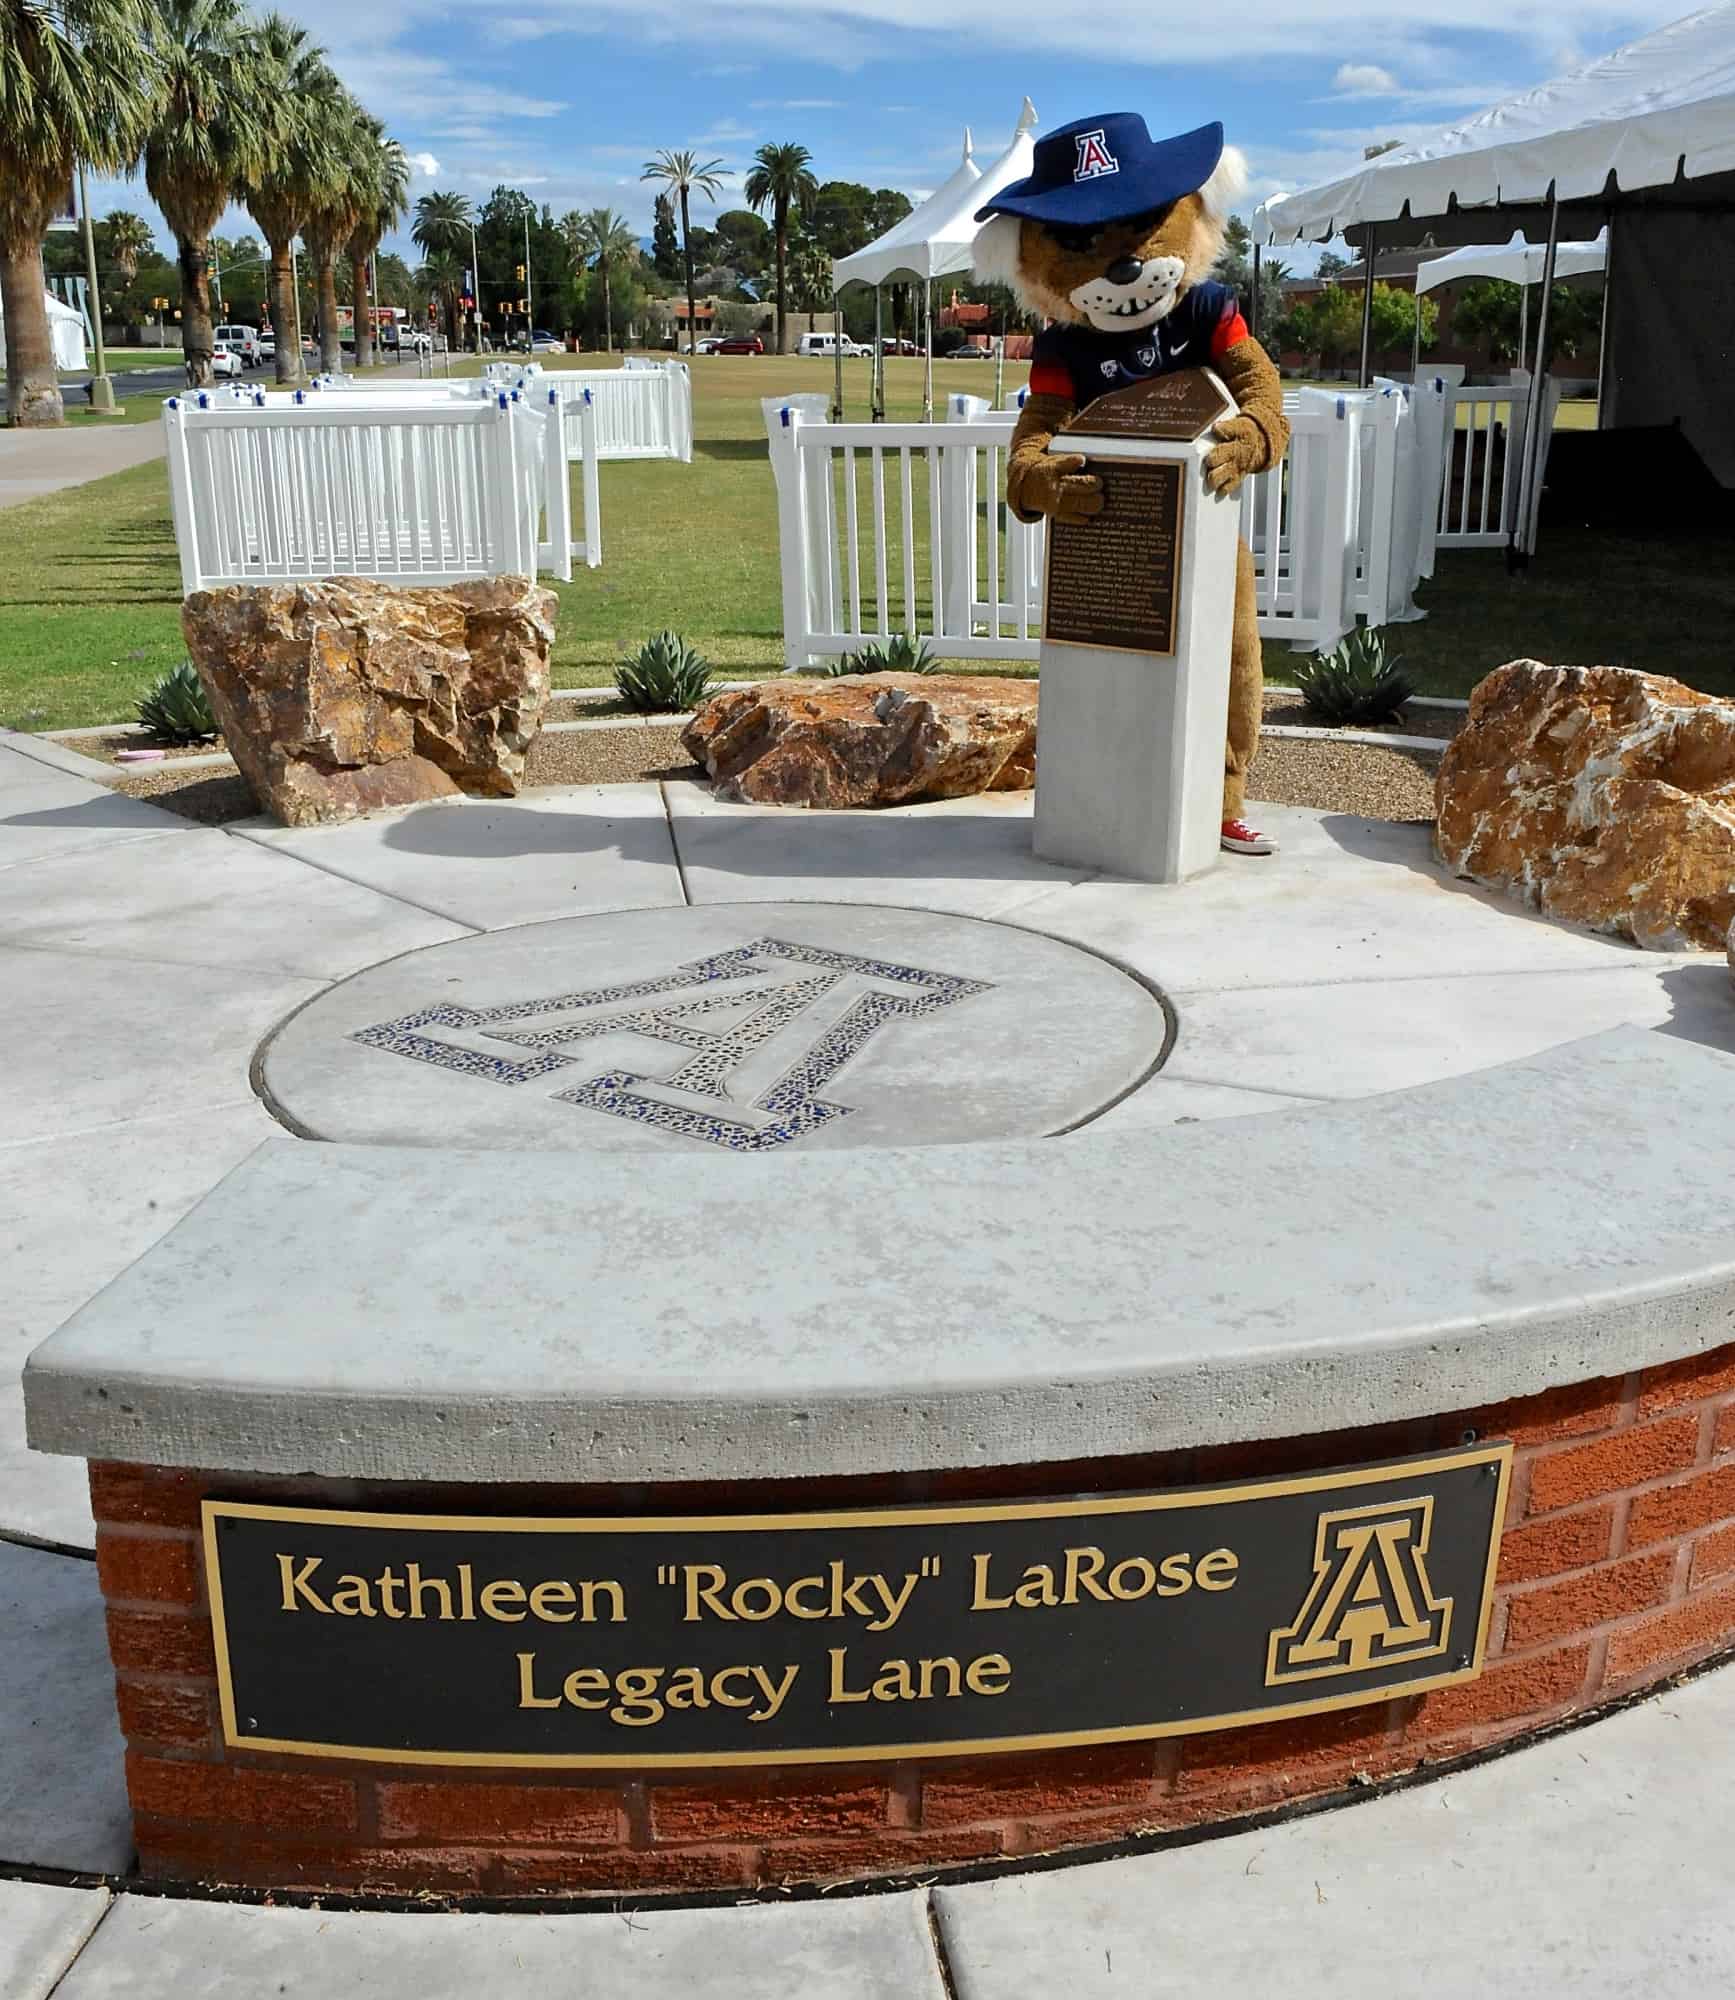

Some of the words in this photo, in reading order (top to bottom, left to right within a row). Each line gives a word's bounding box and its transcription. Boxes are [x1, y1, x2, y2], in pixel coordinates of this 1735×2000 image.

[1073, 129, 1120, 183] A
[345, 938, 999, 1152] A
[275, 1553, 628, 1623] Kathleen
[657, 1555, 942, 1632] "Rocky"
[969, 1546, 1240, 1612] LaRose
[1264, 1495, 1454, 1687] A
[515, 1651, 800, 1727] Legacy
[827, 1645, 1012, 1704] Lane
